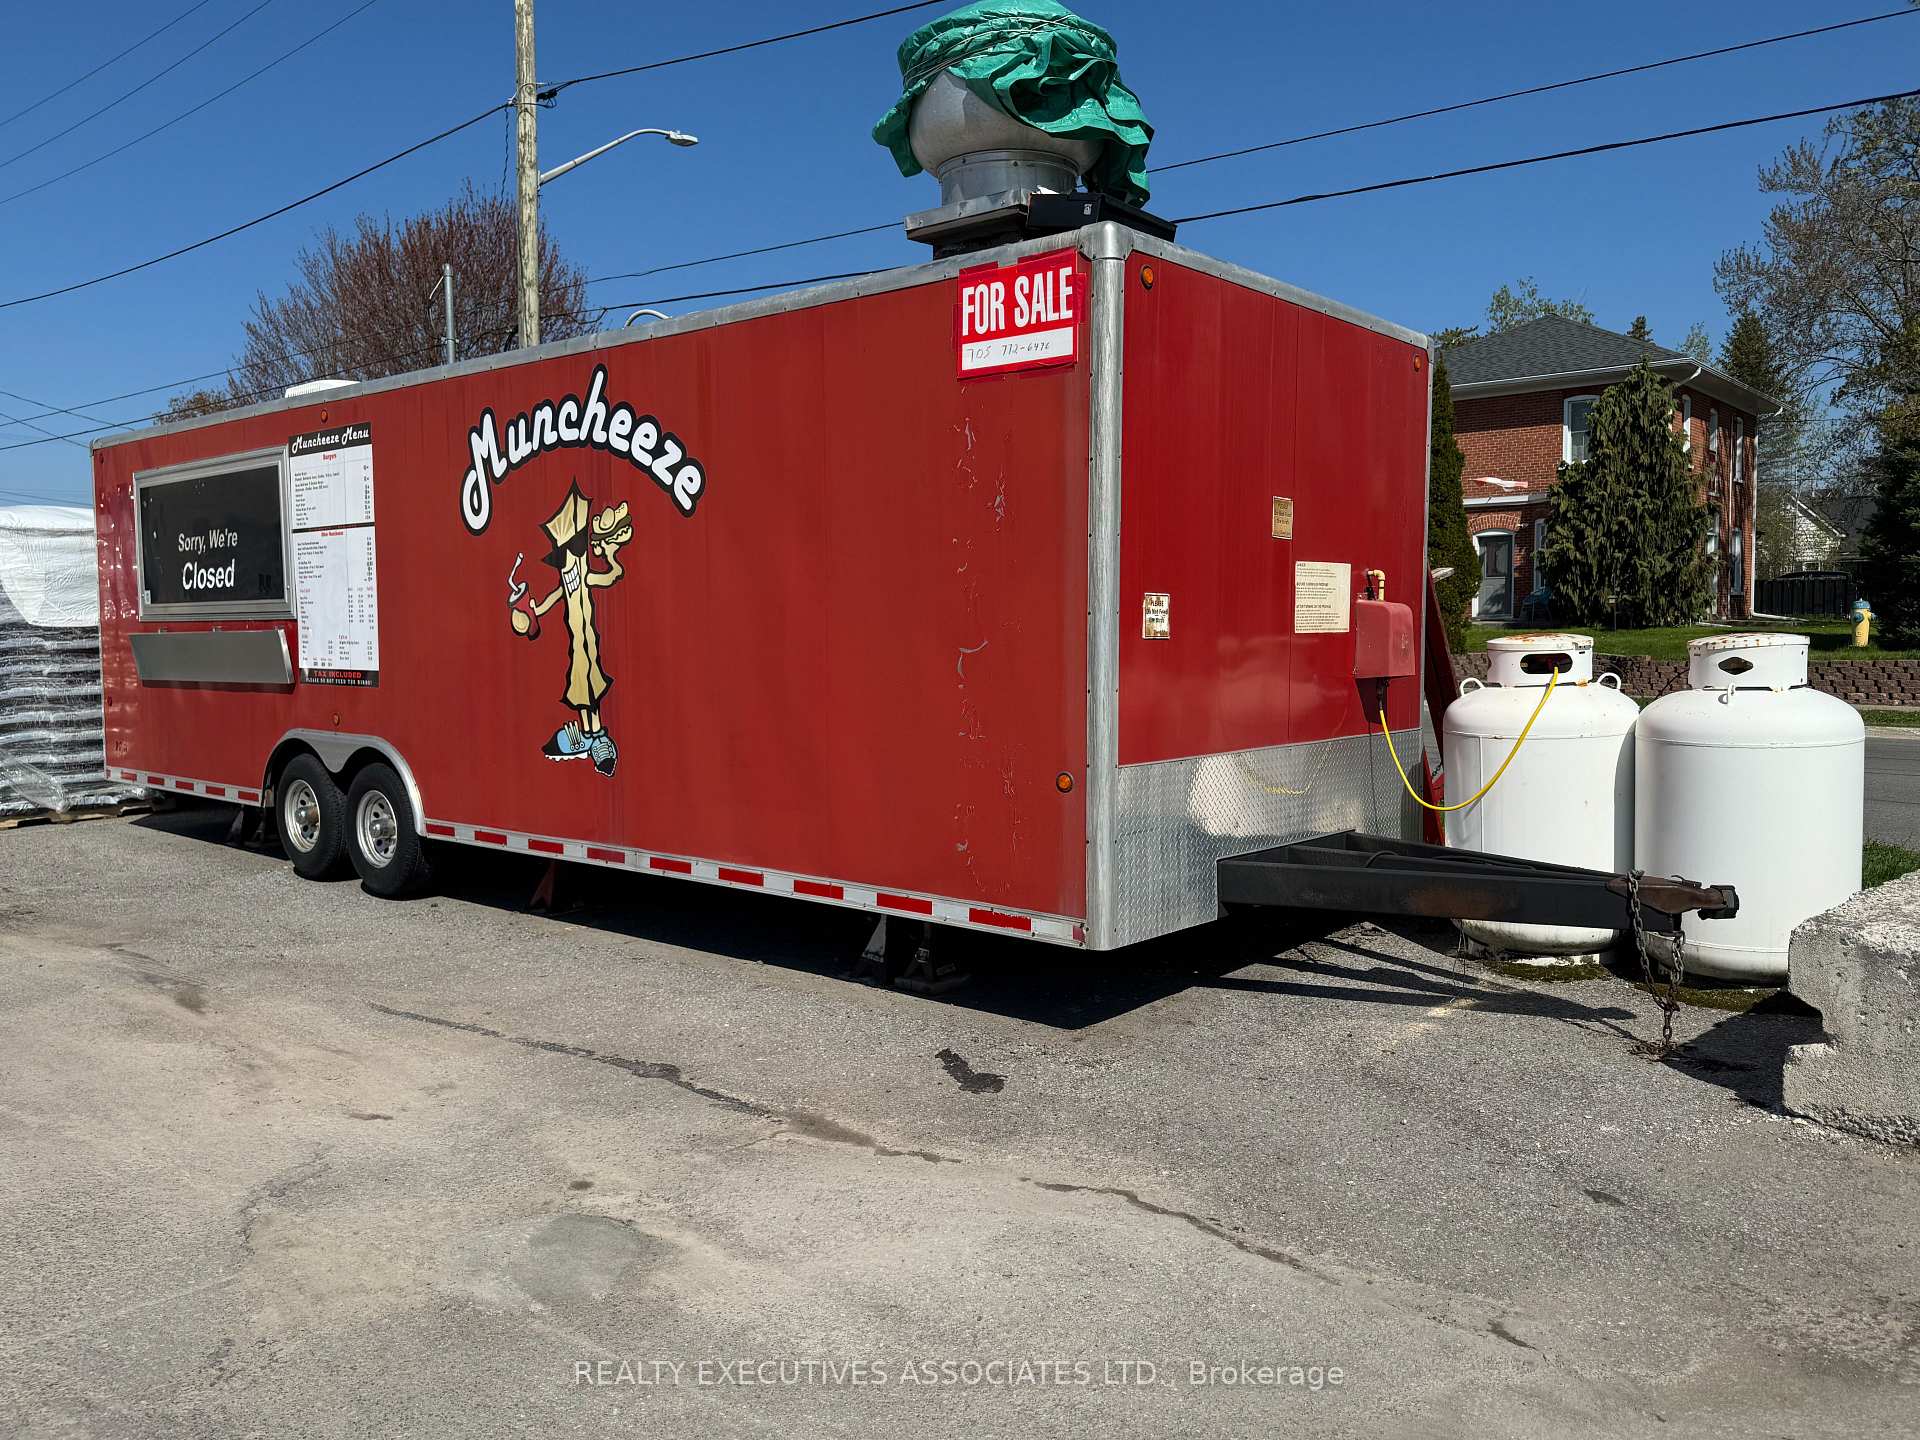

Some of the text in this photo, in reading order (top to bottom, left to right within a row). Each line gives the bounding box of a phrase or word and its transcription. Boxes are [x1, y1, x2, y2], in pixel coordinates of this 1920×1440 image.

[962, 266, 1073, 337] FOR SALE
[966, 345, 992, 363] 705
[291, 427, 370, 454] Muncheeze Menu
[461, 366, 703, 533] Muncheeze
[178, 528, 238, 554] Sorry, We're
[182, 558, 235, 590] Closed
